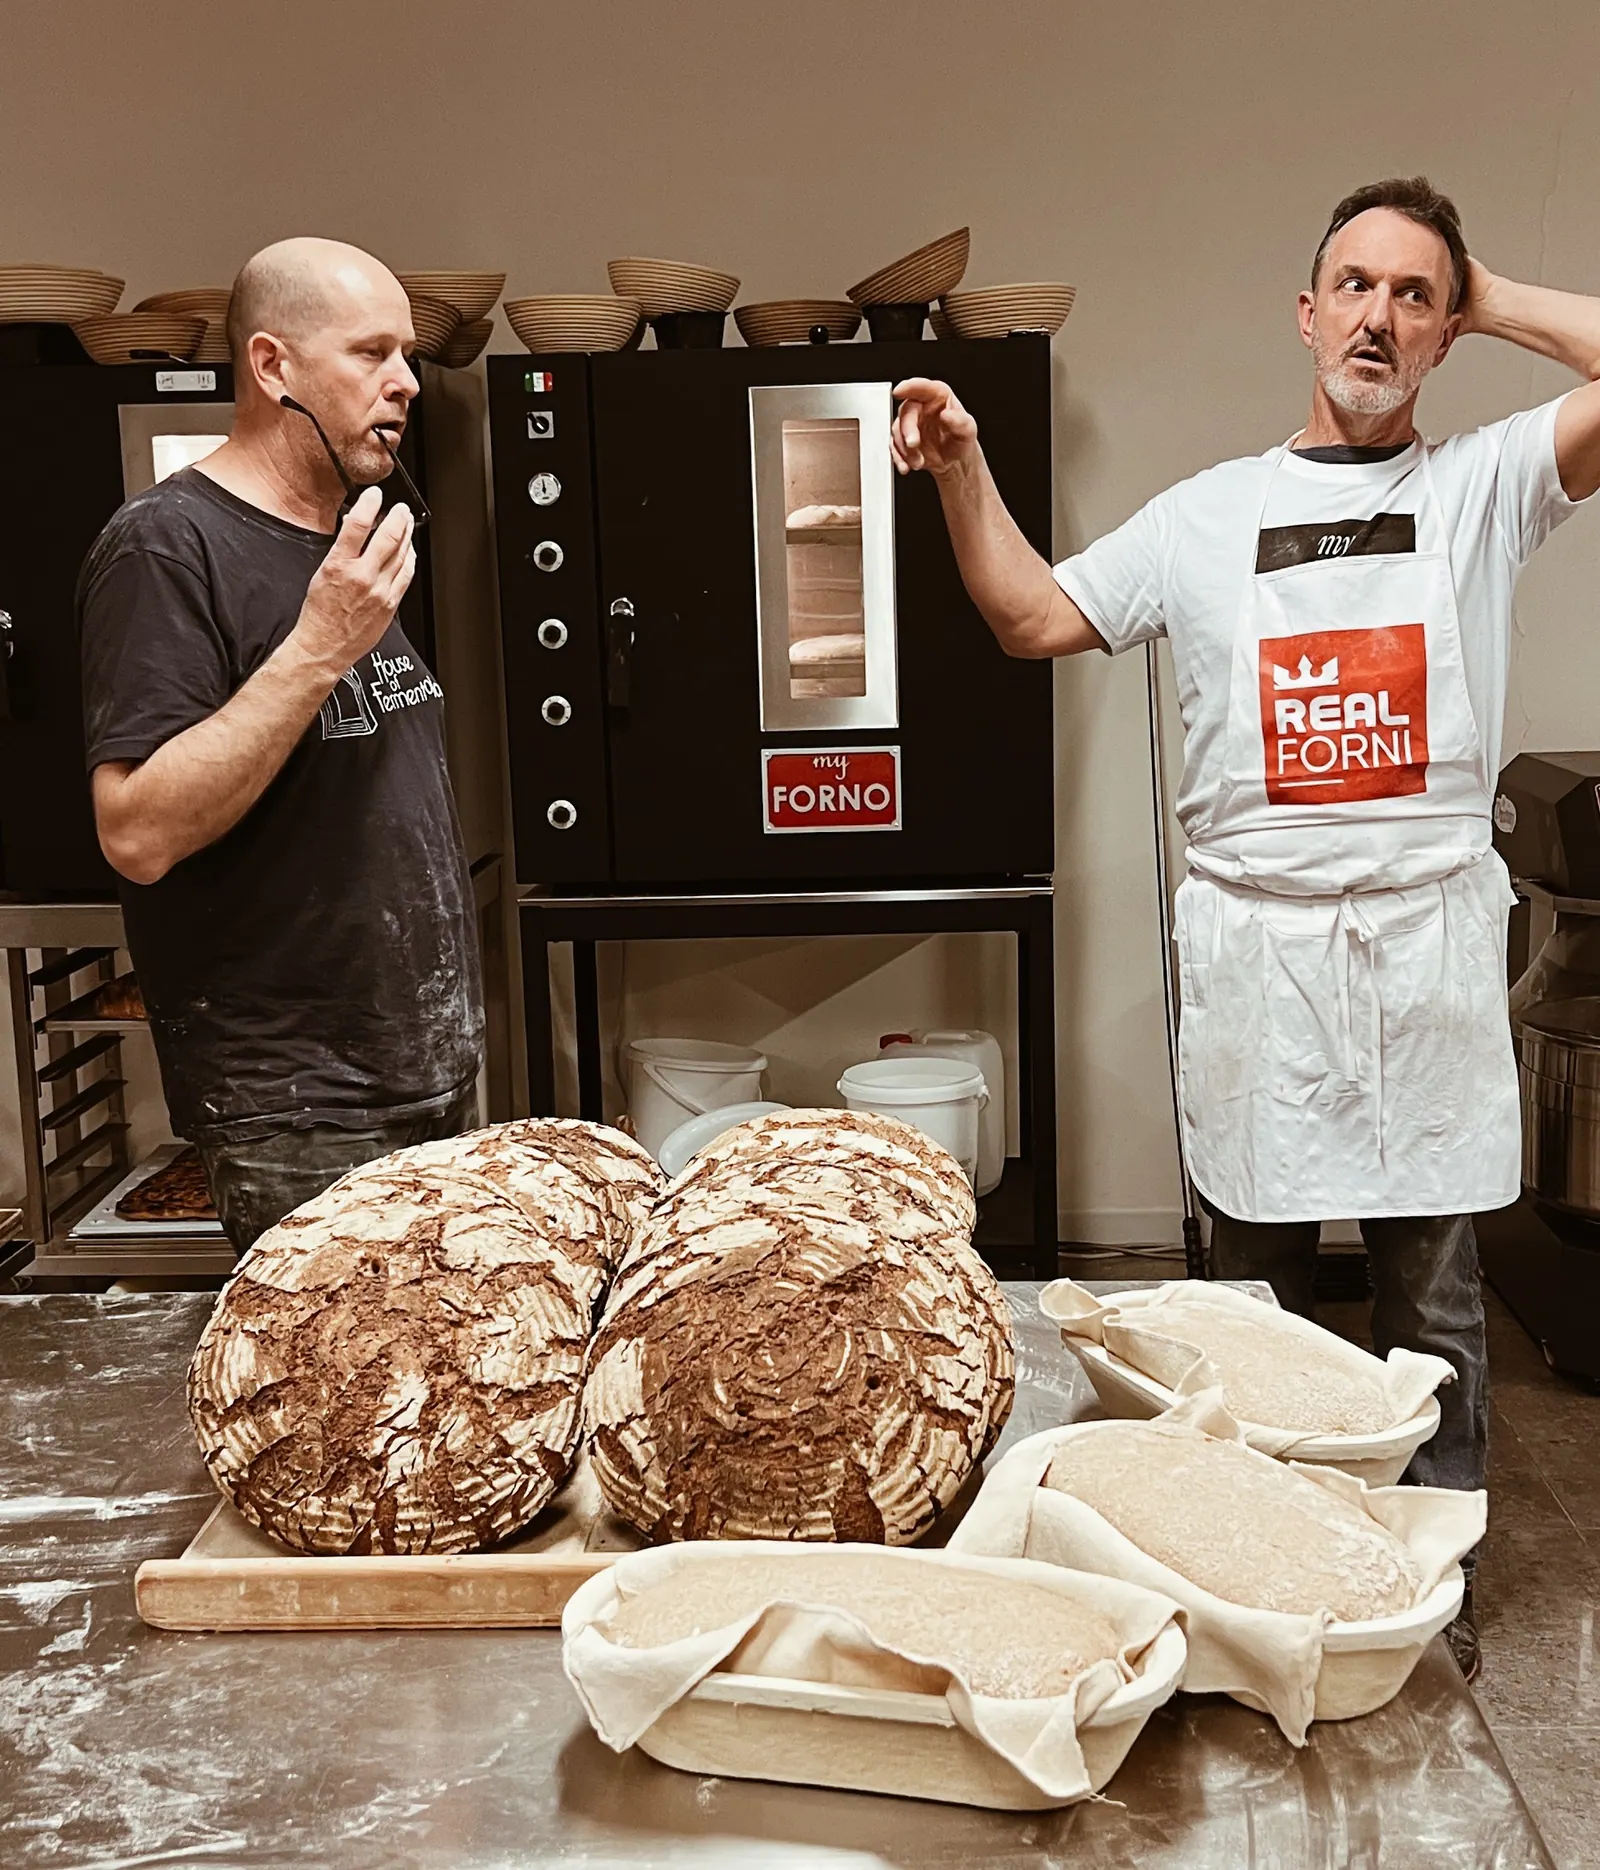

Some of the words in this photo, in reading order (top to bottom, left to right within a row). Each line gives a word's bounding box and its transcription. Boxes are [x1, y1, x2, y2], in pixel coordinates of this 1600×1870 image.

[370, 651, 415, 684] House
[389, 674, 401, 692] of
[1274, 690, 1410, 736] REAL
[812, 755, 851, 780] my
[1277, 729, 1413, 775] FORNI
[773, 783, 891, 813] FORNO
